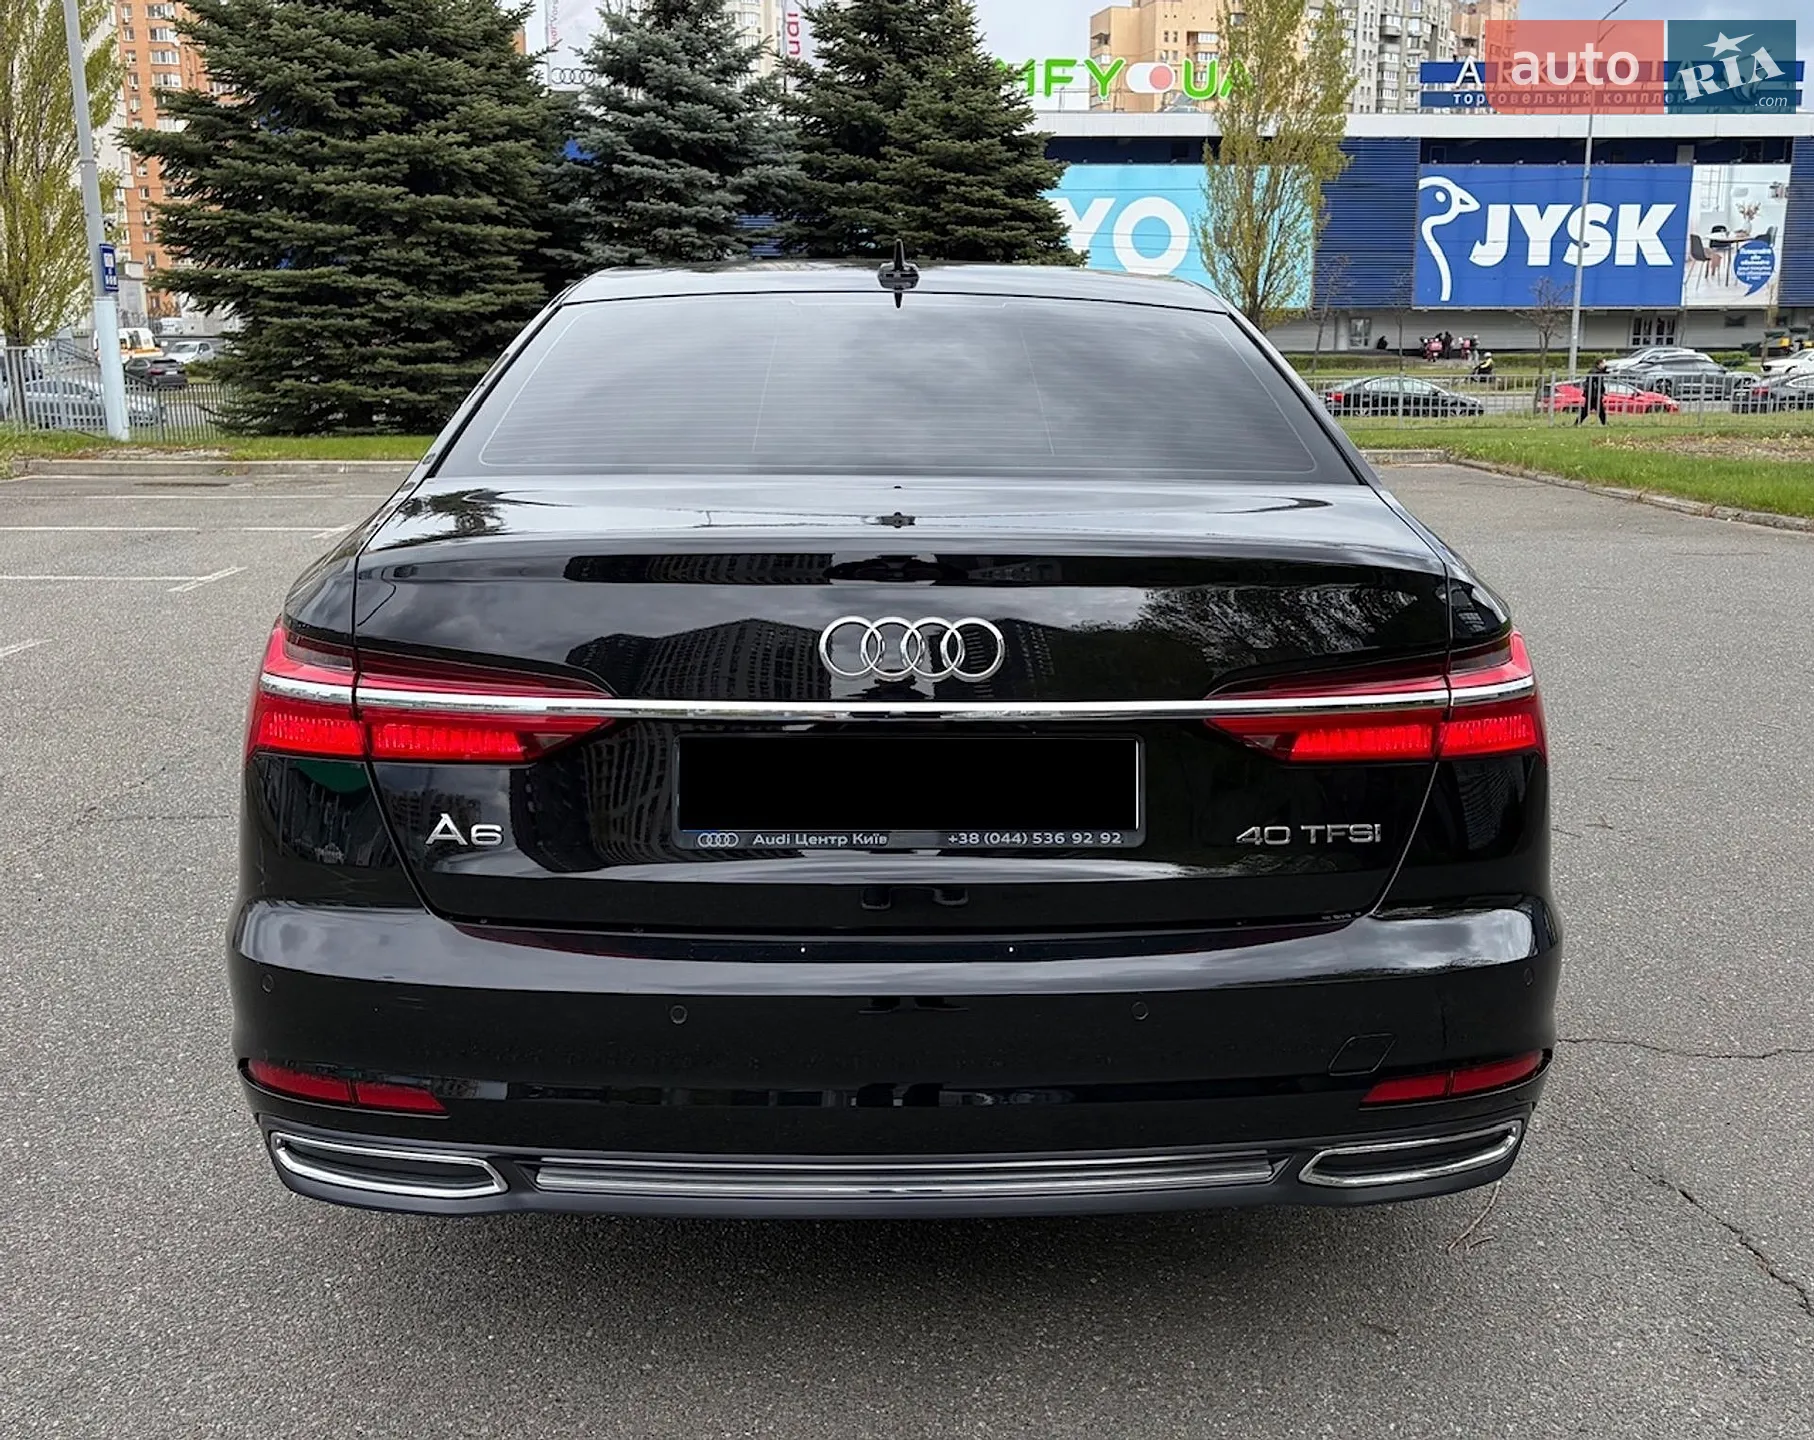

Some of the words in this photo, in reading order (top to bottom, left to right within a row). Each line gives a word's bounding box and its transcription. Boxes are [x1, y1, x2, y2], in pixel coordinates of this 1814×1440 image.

[1469, 203, 1677, 267] JYSK
[425, 812, 503, 846] A6
[752, 833, 790, 845] Audi
[795, 833, 849, 847] Центр
[852, 832, 888, 845] Київ
[948, 832, 980, 844] +38
[983, 832, 1028, 845] (044)
[1032, 832, 1066, 844] 536
[1071, 832, 1094, 844] 92
[1099, 832, 1122, 844] 92
[1236, 826, 1291, 845] 40
[1300, 823, 1382, 844] TFSI
